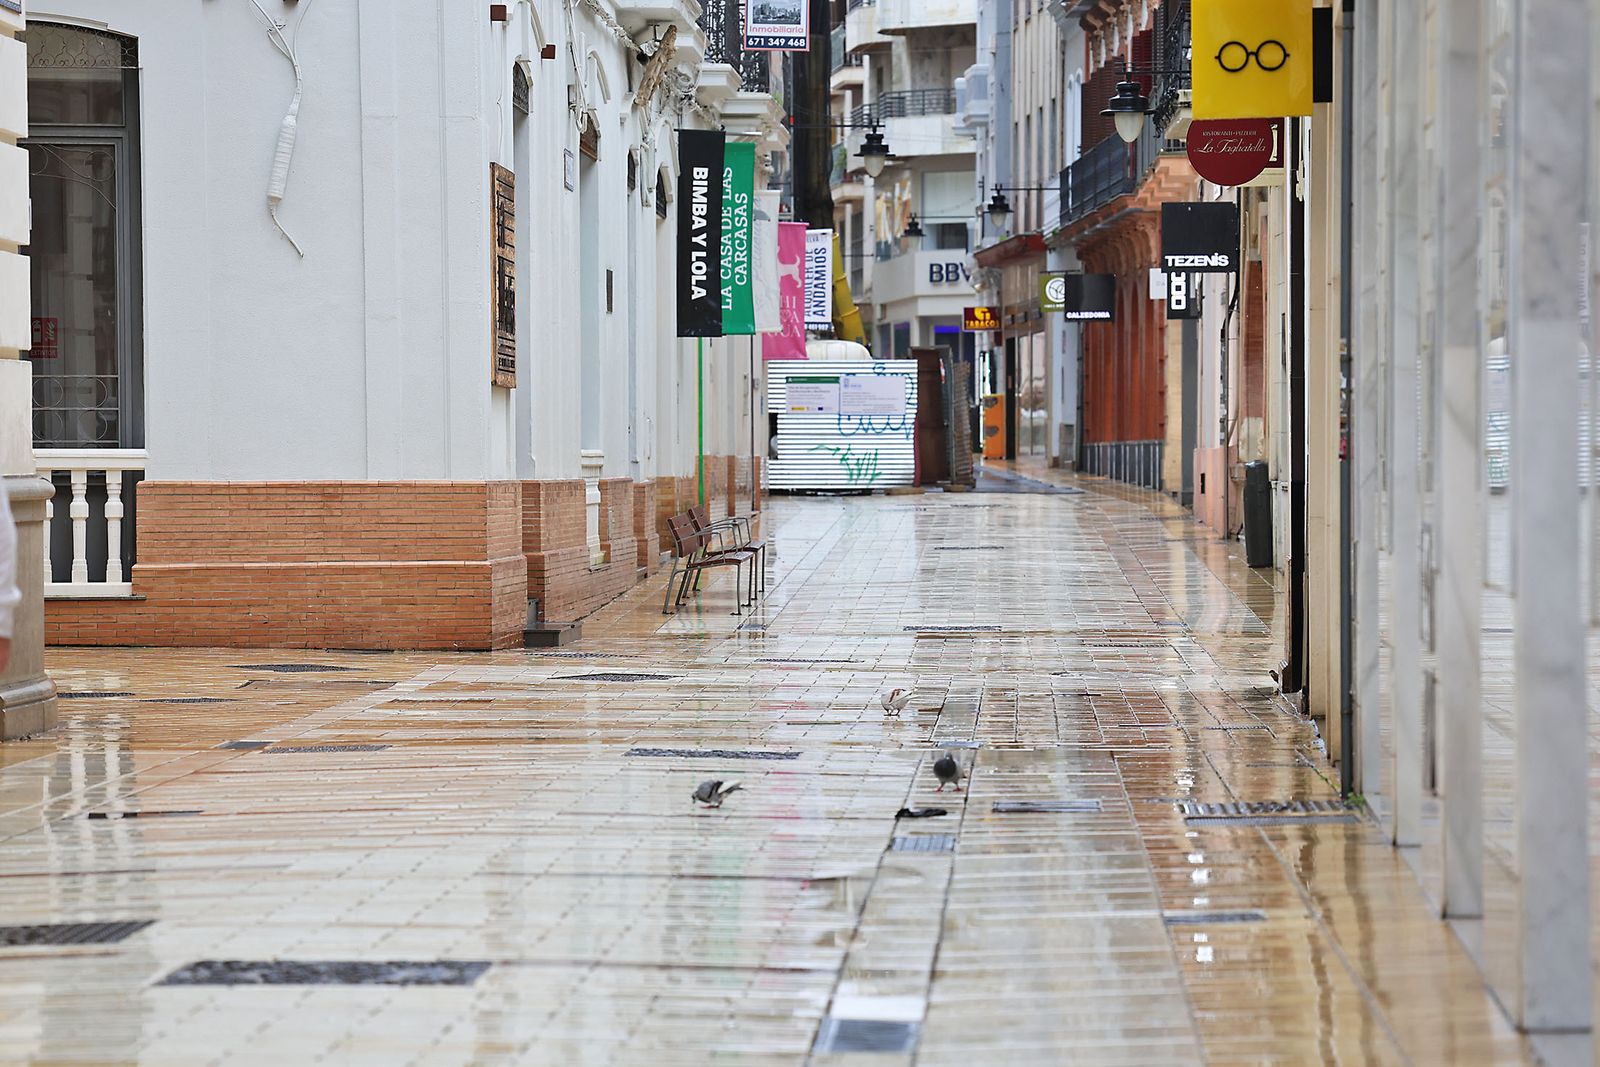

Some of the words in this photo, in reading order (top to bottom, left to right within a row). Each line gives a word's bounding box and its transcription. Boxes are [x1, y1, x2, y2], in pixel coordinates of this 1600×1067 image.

[748, 38, 764, 46] 671
[767, 38, 785, 47] 349
[787, 38, 806, 47] 468
[749, 26, 804, 34] Inmobiliaria
[1194, 138, 1213, 154] La
[1214, 137, 1266, 155] Tagliatella
[691, 166, 709, 231] BIMBA
[722, 167, 733, 201] LAS
[721, 206, 733, 230] DE
[691, 232, 707, 248] Y
[734, 192, 748, 286] CARCASAS
[720, 233, 733, 280] CASA
[691, 251, 707, 301] LOLA
[812, 247, 827, 317] ANDAMIOS
[720, 285, 733, 311] LA
